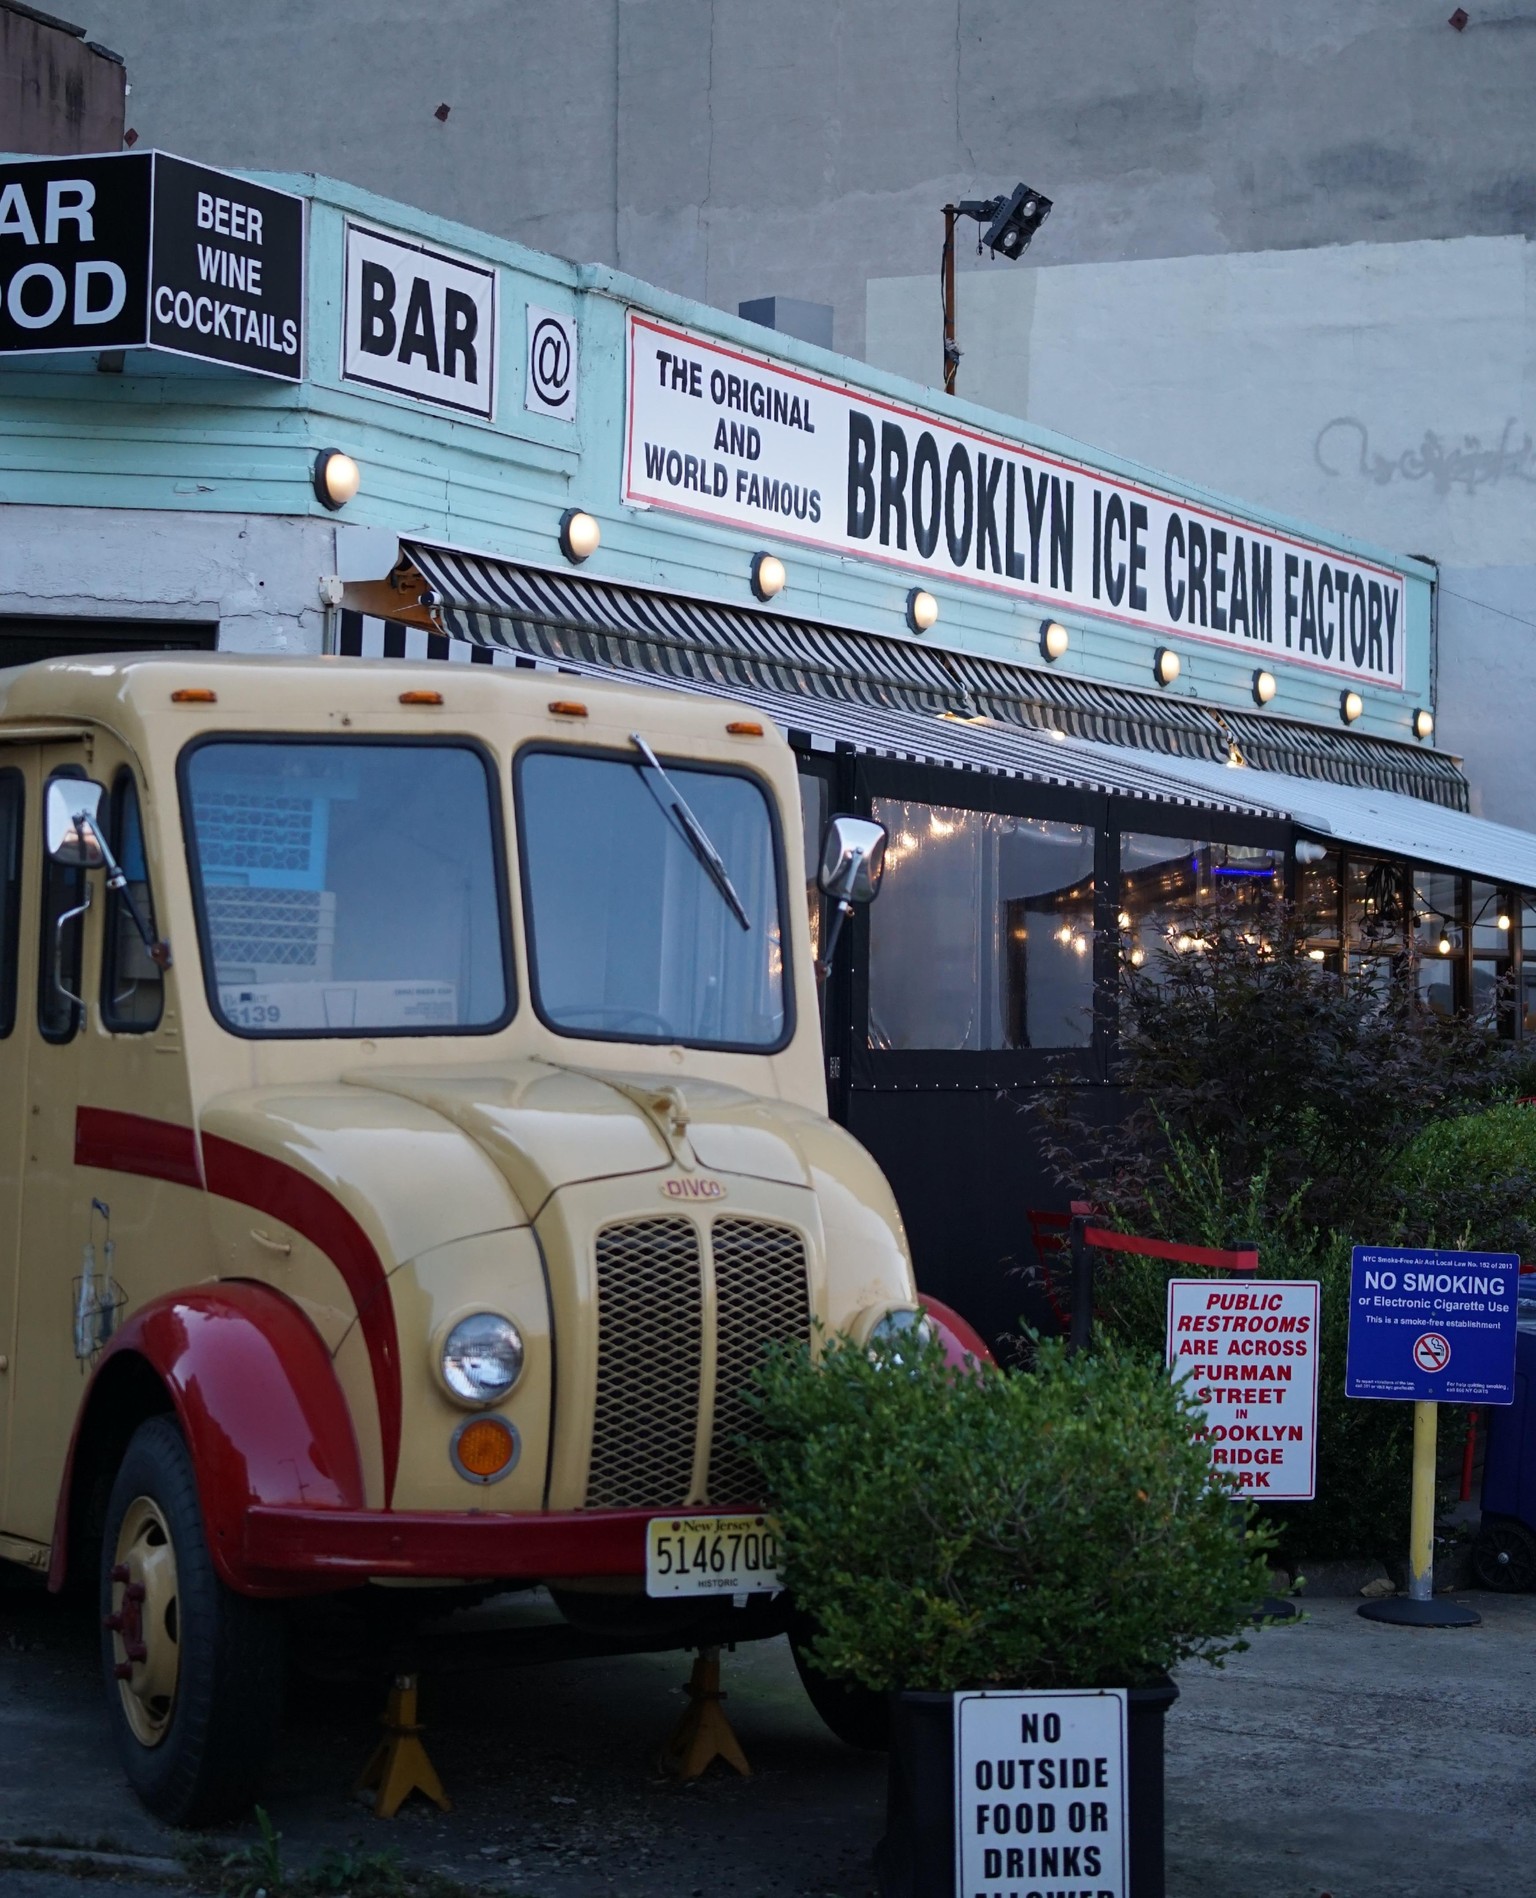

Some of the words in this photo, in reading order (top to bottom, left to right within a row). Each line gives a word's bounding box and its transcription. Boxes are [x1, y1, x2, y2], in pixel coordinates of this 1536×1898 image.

[197, 191, 263, 245] BEER
[197, 243, 262, 296] WINE
[0, 260, 127, 329] OD
[155, 286, 298, 355] COCKTAILS
[360, 259, 479, 385] BAR
[531, 317, 571, 407] @
[656, 349, 702, 398] THE
[710, 369, 815, 433] ORIGINAL
[714, 417, 761, 461] AND
[644, 442, 728, 498] WORLD
[736, 469, 821, 523] FAMOUS
[847, 409, 1074, 593] BROOKLYN
[1092, 489, 1148, 612] ICE
[1164, 512, 1273, 644] CREAM
[1284, 552, 1399, 675] FACTORY
[667, 1179, 721, 1196] DIVCO
[1362, 1255, 1376, 1263] NYC
[1365, 1271, 1397, 1290] NO
[1403, 1273, 1505, 1296] SMOKING
[1206, 1294, 1283, 1311] PUBLIC
[1358, 1297, 1371, 1306] or
[1373, 1295, 1431, 1309] Electronic
[1433, 1298, 1485, 1312] Cigarette
[1488, 1301, 1509, 1313] Use
[1177, 1315, 1310, 1333] RESTROOMS
[1366, 1315, 1383, 1324] This
[1384, 1315, 1392, 1324] is
[1400, 1317, 1445, 1327] smoke-free
[1446, 1319, 1501, 1329] establishment
[1179, 1339, 1218, 1355] ARE
[1227, 1339, 1307, 1356] ACROSS
[1193, 1365, 1292, 1381] FURMAN
[1198, 1387, 1286, 1404] STREET
[1235, 1409, 1248, 1419] IN
[1206, 1448, 1284, 1464] RIDGE
[683, 1520, 710, 1532] New
[715, 1519, 753, 1533] Jersey
[698, 1578, 738, 1588] HISTORIC
[1021, 1712, 1061, 1744] NO
[975, 1757, 1108, 1790] OUTSIDE
[977, 1803, 1055, 1834] FOOD
[1068, 1801, 1108, 1833] OR
[984, 1845, 1102, 1879] DRINKS
